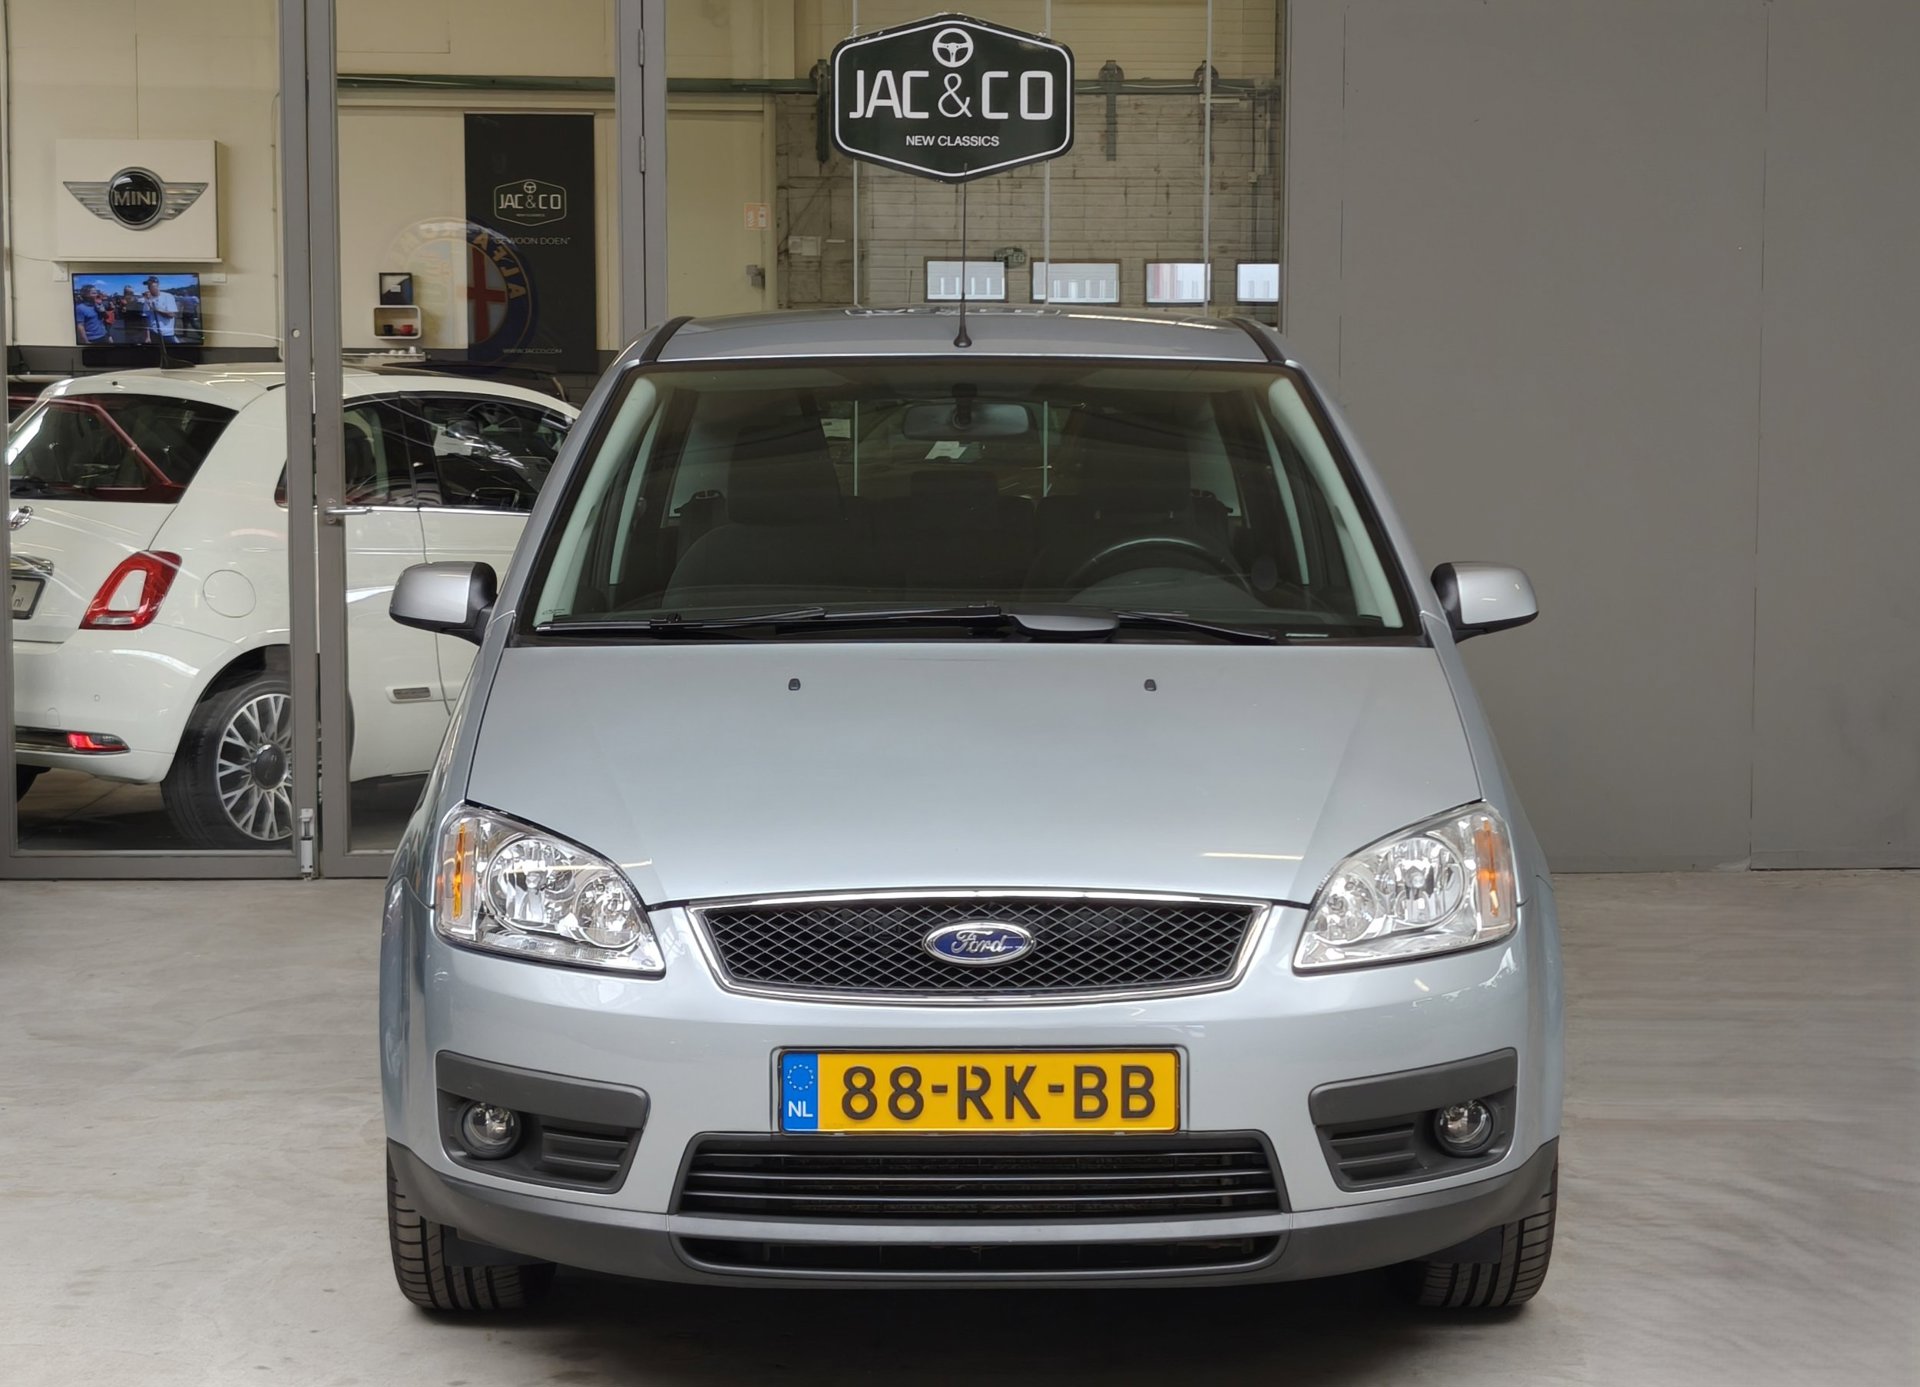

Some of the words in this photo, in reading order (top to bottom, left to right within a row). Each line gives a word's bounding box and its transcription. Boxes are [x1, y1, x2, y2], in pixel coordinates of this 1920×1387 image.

[905, 135, 936, 146] NEW
[937, 135, 1000, 147] CLASSICS
[113, 190, 157, 207] MINI
[950, 930, 1008, 954] Ford
[841, 1064, 1156, 1121] 88-RK-BB
[786, 1100, 814, 1118] NL
